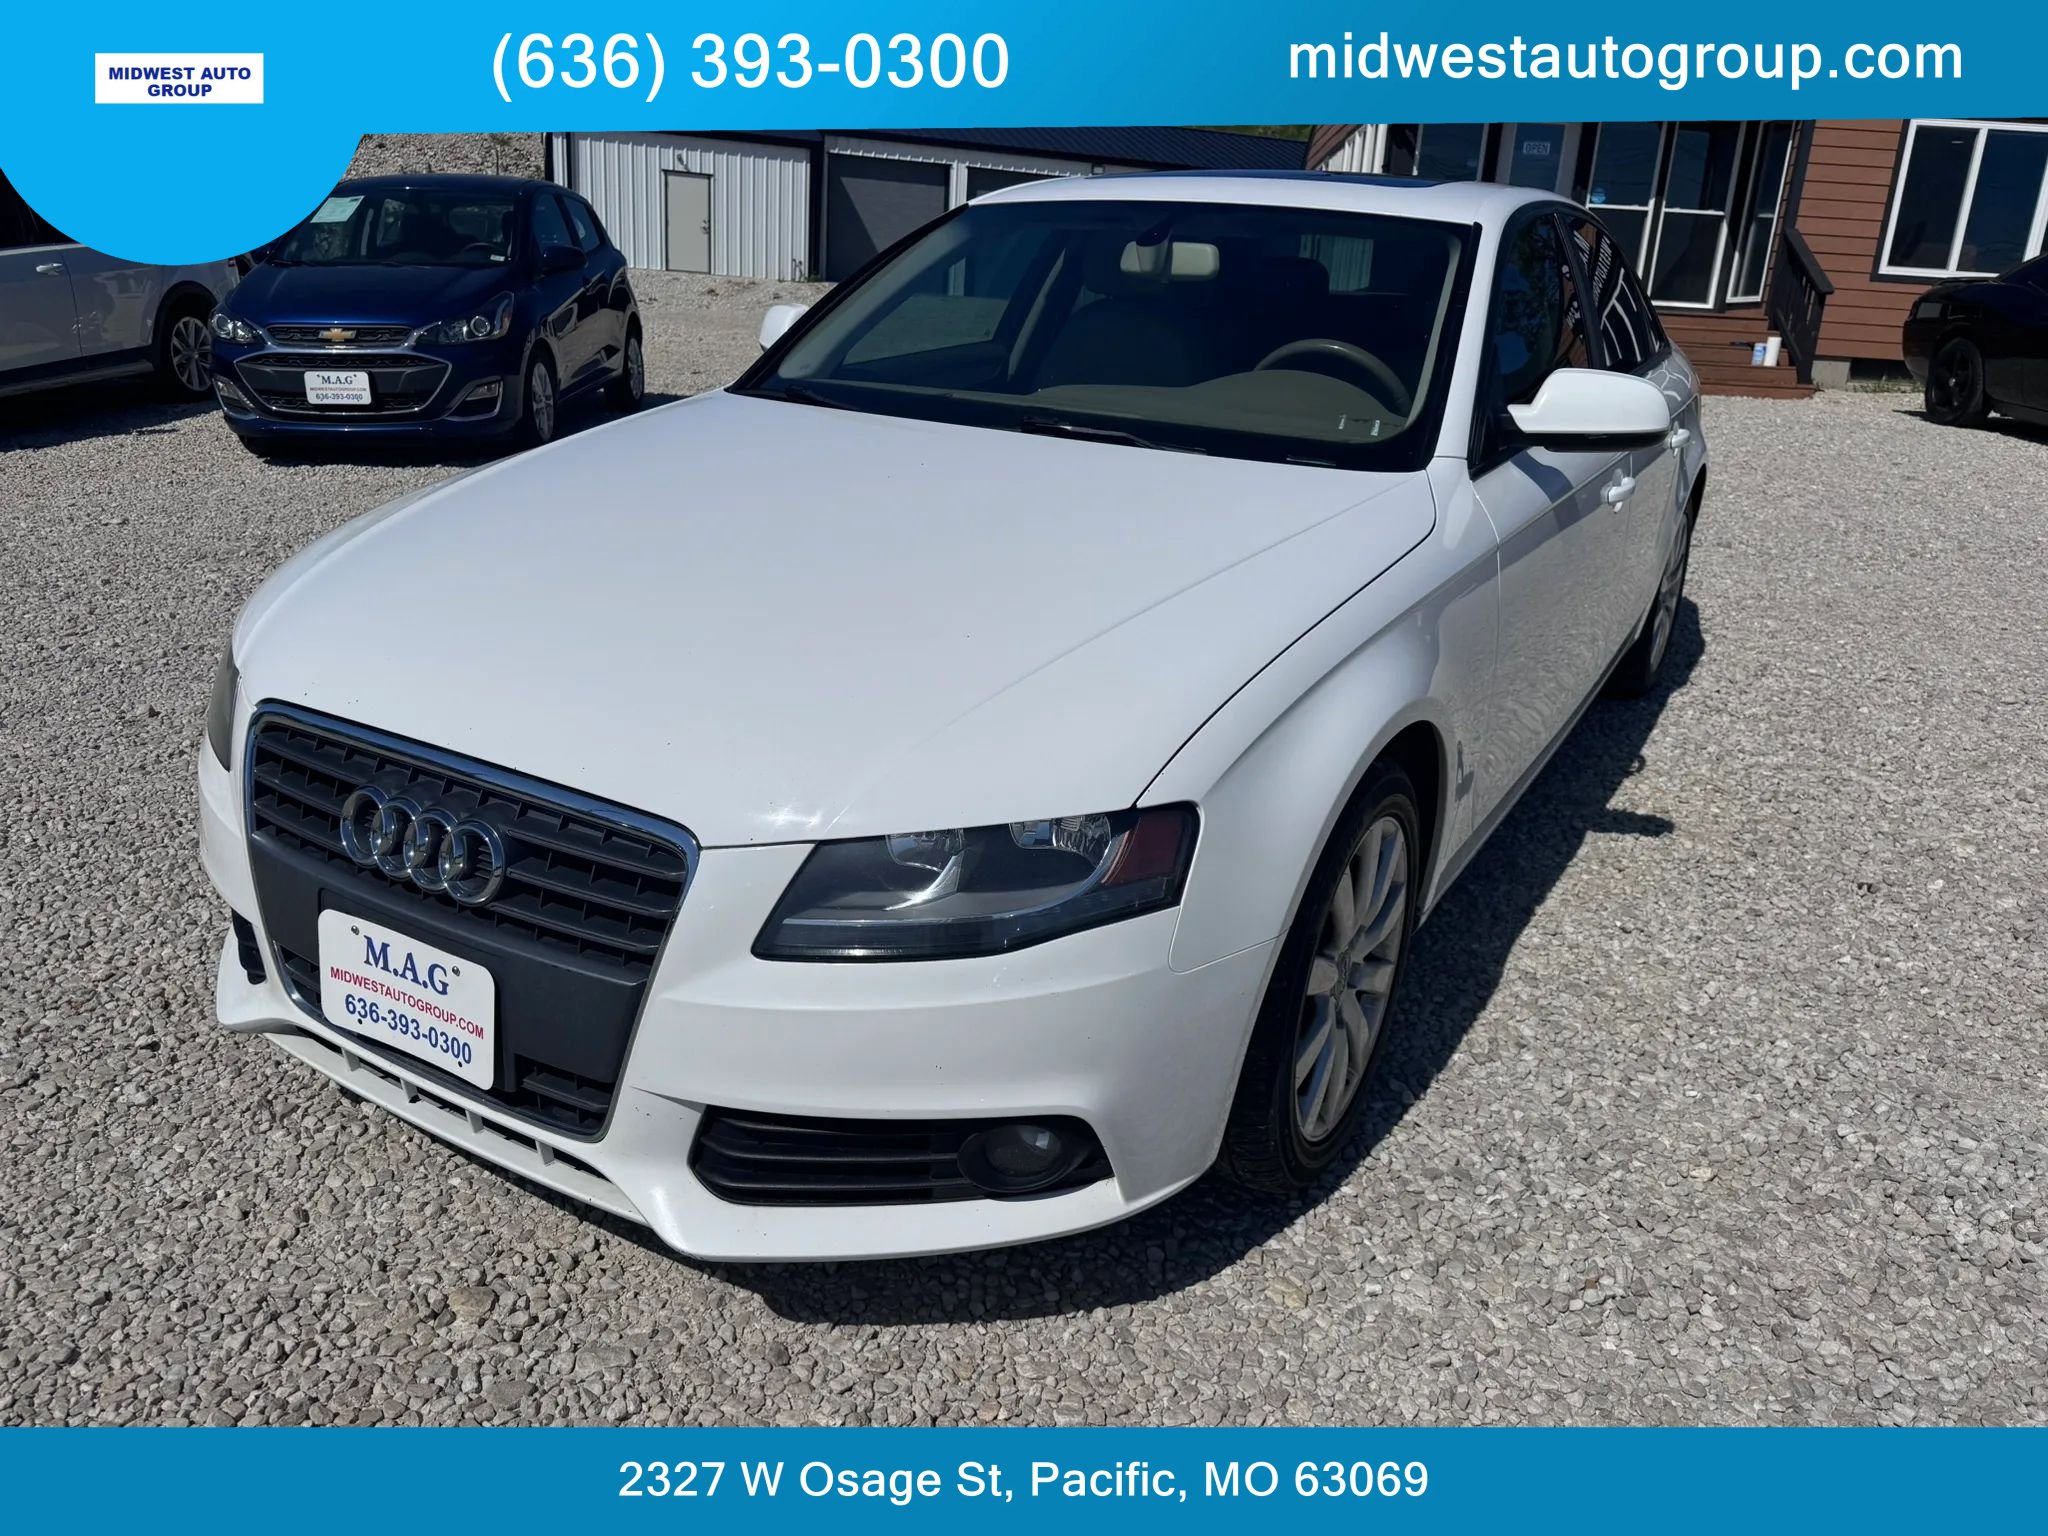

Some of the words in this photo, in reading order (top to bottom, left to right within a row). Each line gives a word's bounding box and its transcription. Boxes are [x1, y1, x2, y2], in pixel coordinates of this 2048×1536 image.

[321, 375, 353, 385] M.A.G
[363, 935, 449, 996] M.A.G
[330, 966, 484, 1040] MIDWESTAUTOGROUP.COM
[345, 993, 472, 1065] 636-393-0300
